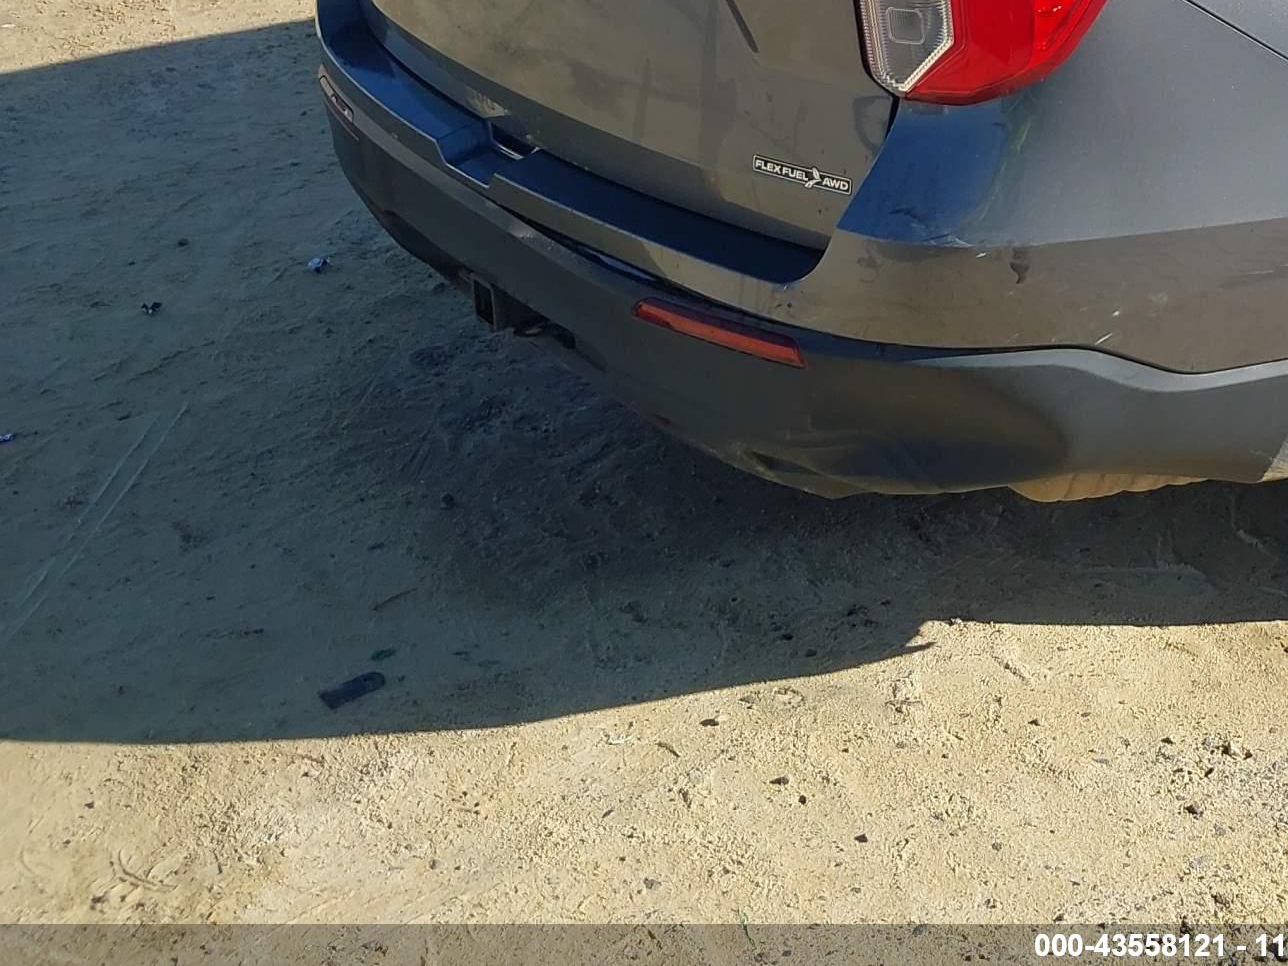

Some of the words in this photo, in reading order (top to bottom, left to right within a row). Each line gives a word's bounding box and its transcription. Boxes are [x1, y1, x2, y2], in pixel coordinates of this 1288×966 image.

[755, 159, 781, 174] FLEX
[782, 167, 809, 181] FUEL
[822, 177, 849, 191] AWD
